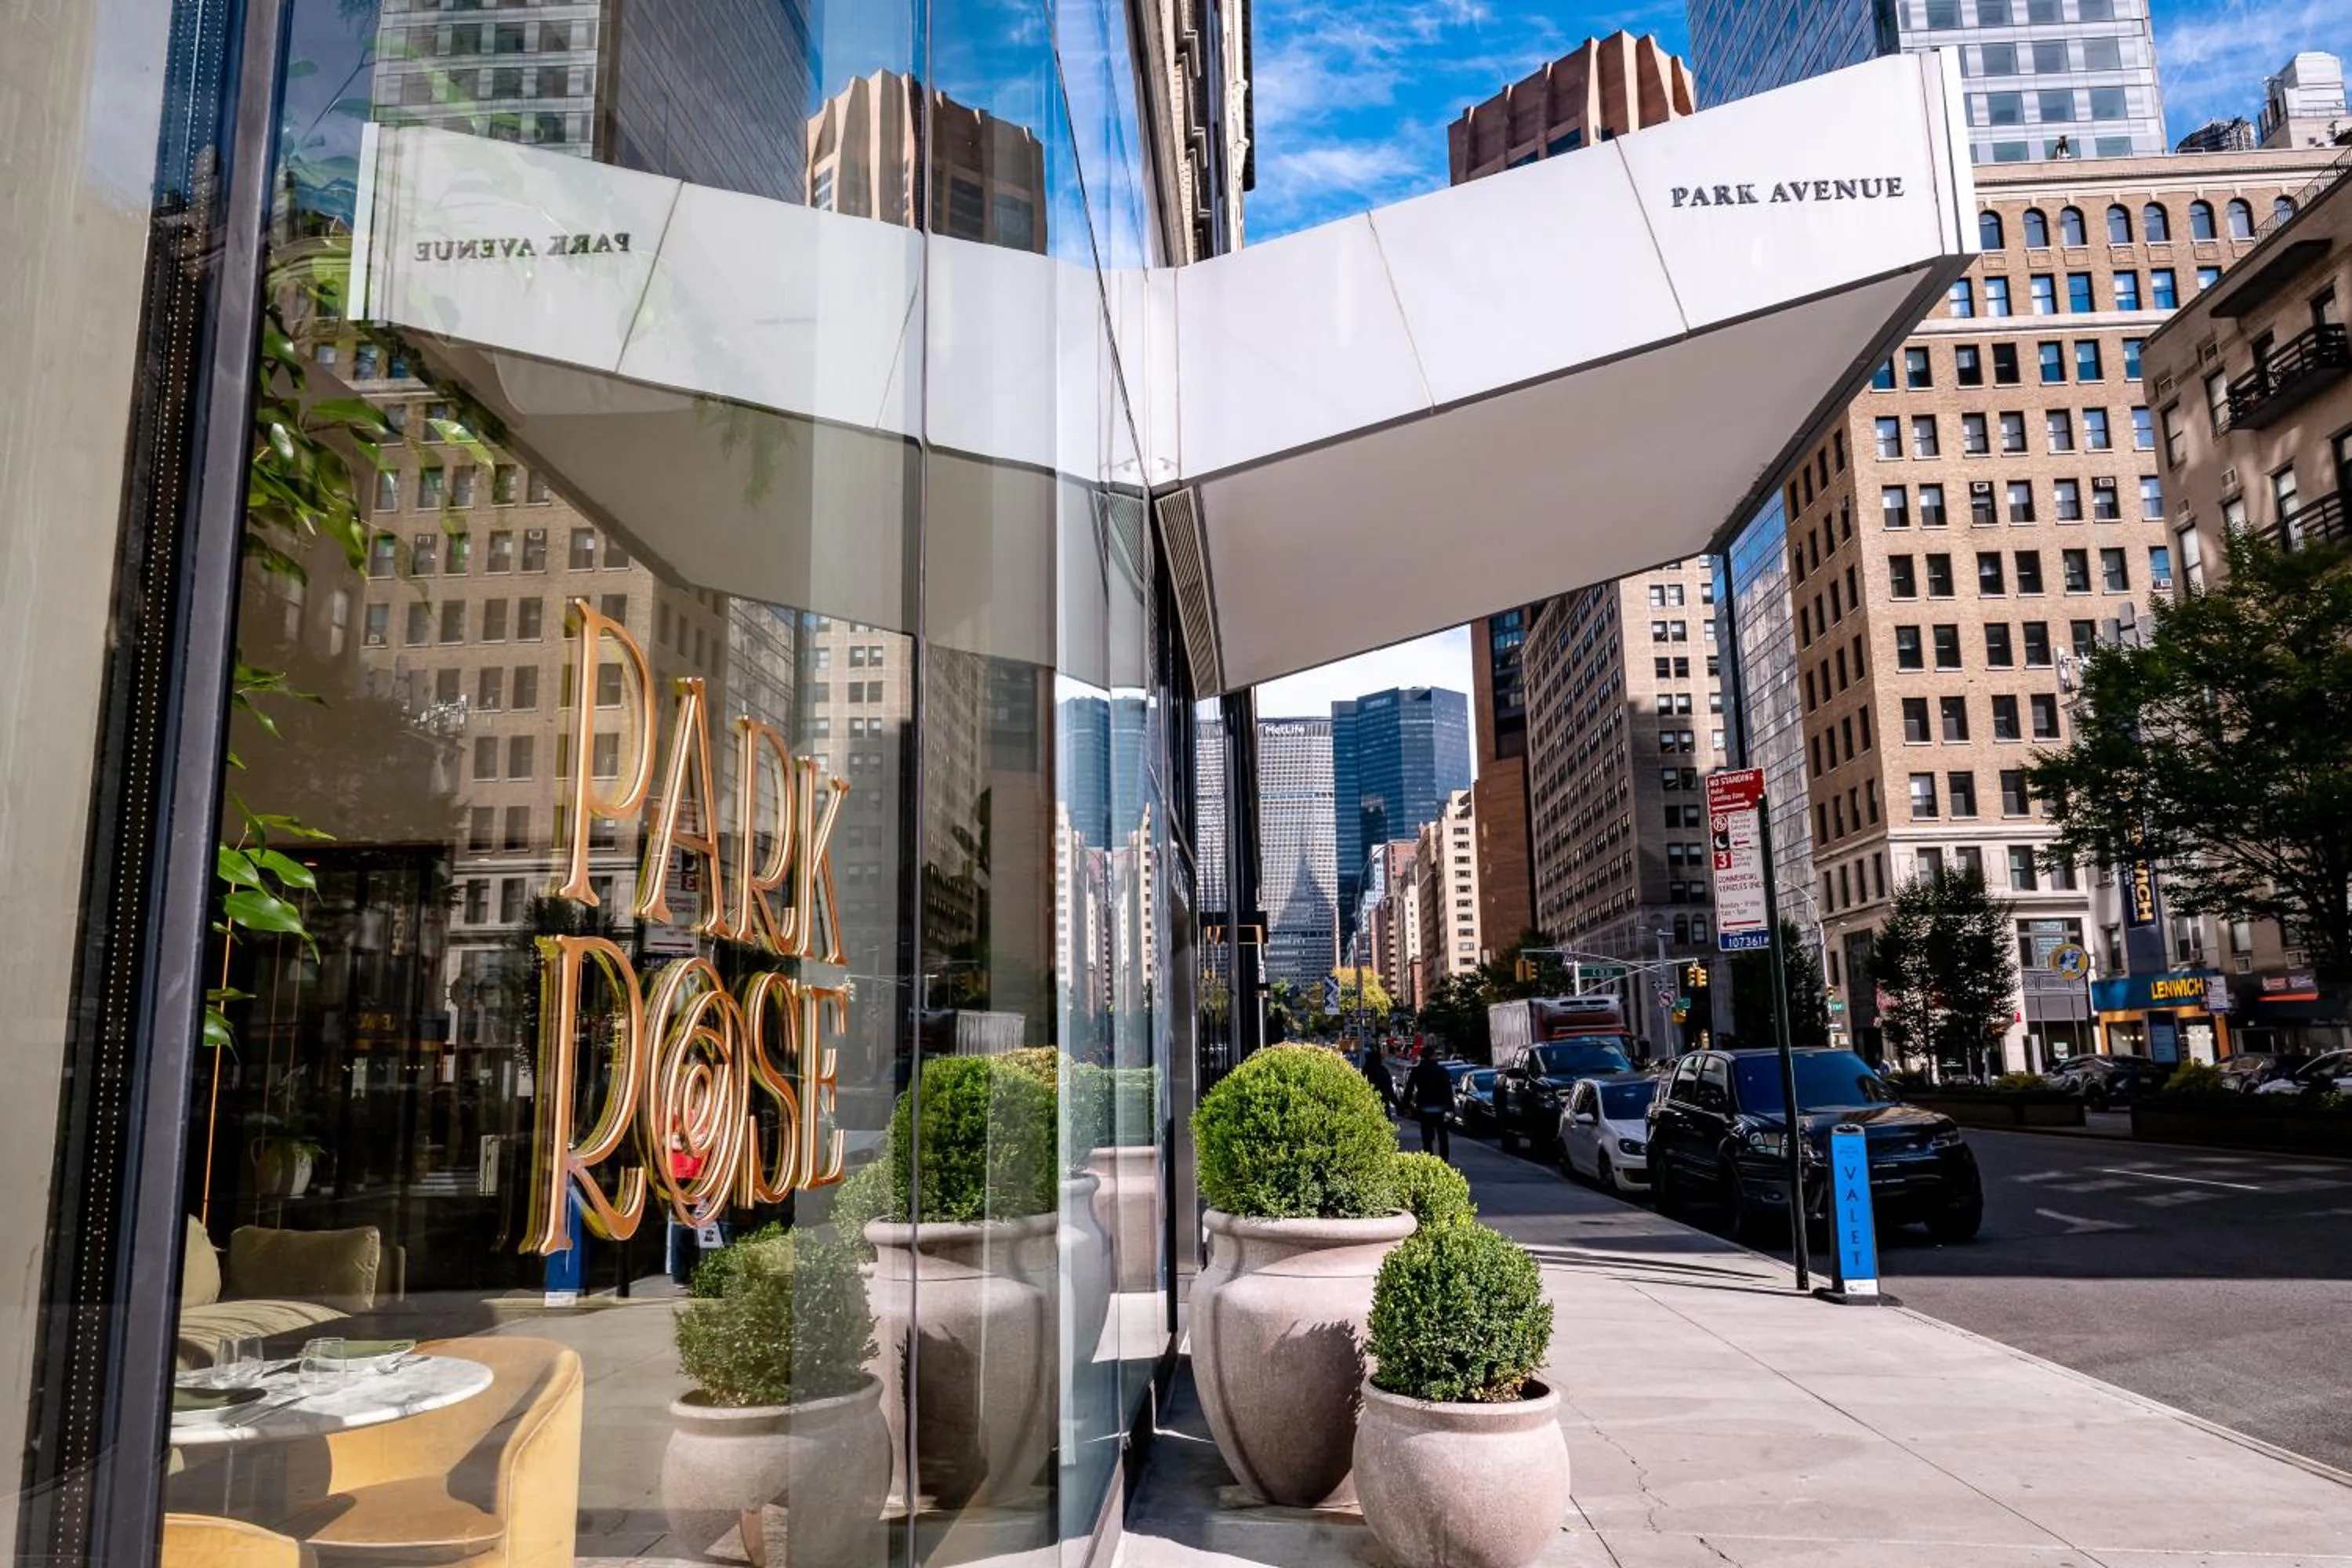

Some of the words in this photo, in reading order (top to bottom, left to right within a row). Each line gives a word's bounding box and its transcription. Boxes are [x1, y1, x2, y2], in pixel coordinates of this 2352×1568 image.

[1670, 183, 1759, 208] PARK
[1769, 176, 1905, 203] AVENUE
[555, 597, 851, 965] PARK
[1718, 852, 1727, 868] 3
[1729, 935, 1762, 948] 107361
[2151, 977, 2205, 1001] LENWICH
[525, 934, 848, 1255] ROSE
[1843, 1166, 1861, 1267] VALET
